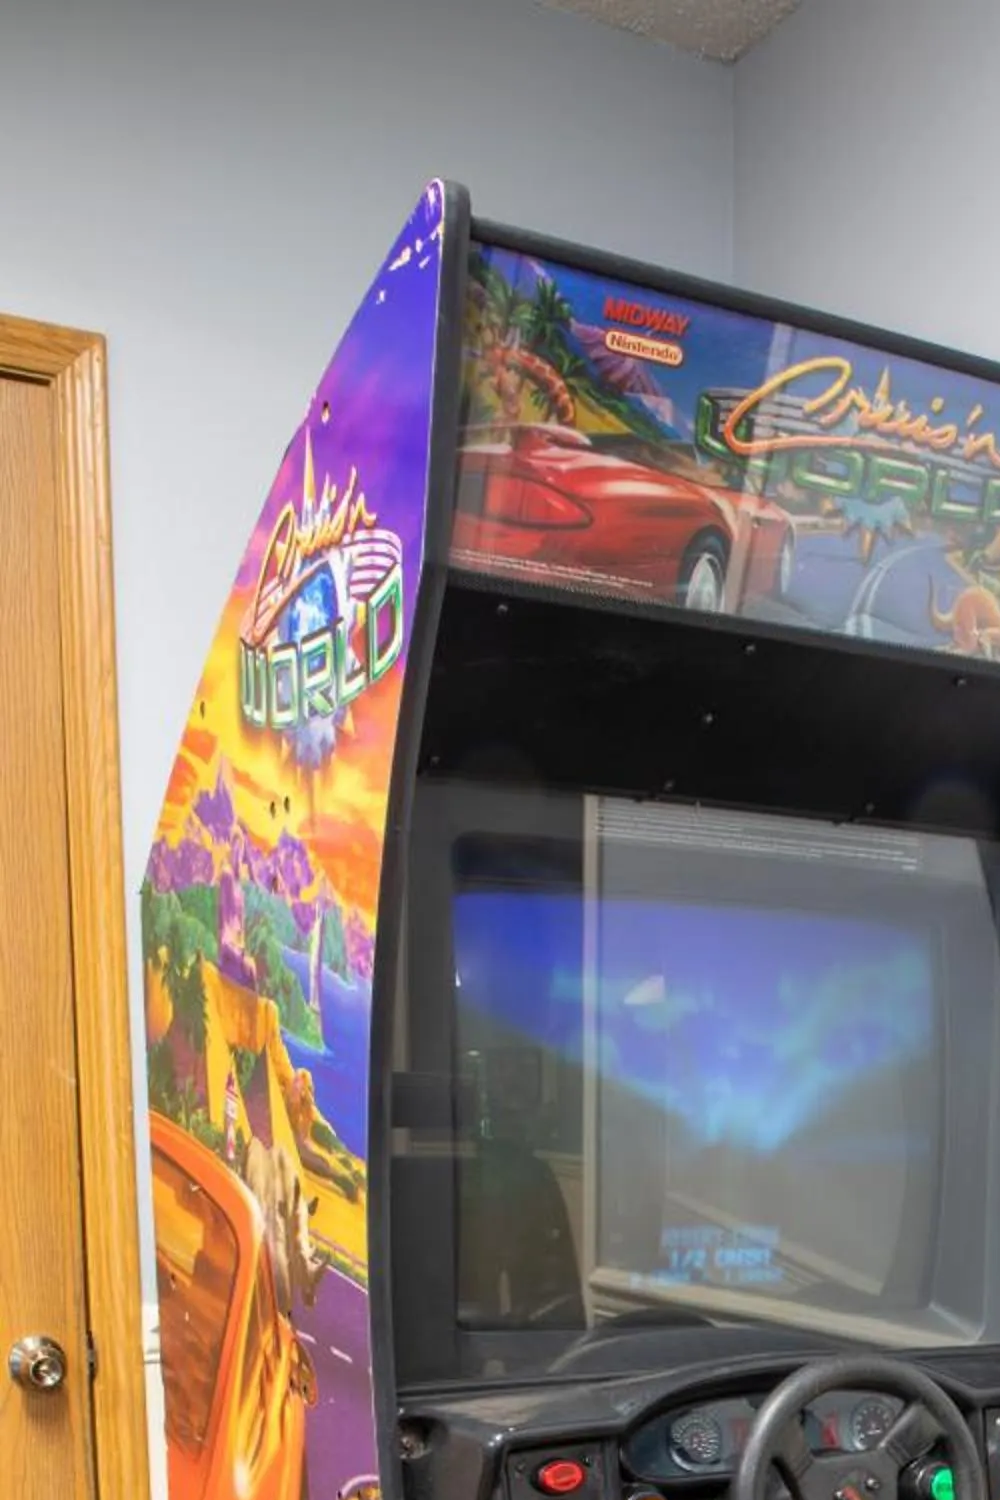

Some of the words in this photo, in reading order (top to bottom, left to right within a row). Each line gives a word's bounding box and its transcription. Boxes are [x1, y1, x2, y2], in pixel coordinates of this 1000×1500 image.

[604, 296, 690, 336] MIDWAY
[609, 333, 678, 361] Nintendo
[239, 562, 403, 730] WORLD
